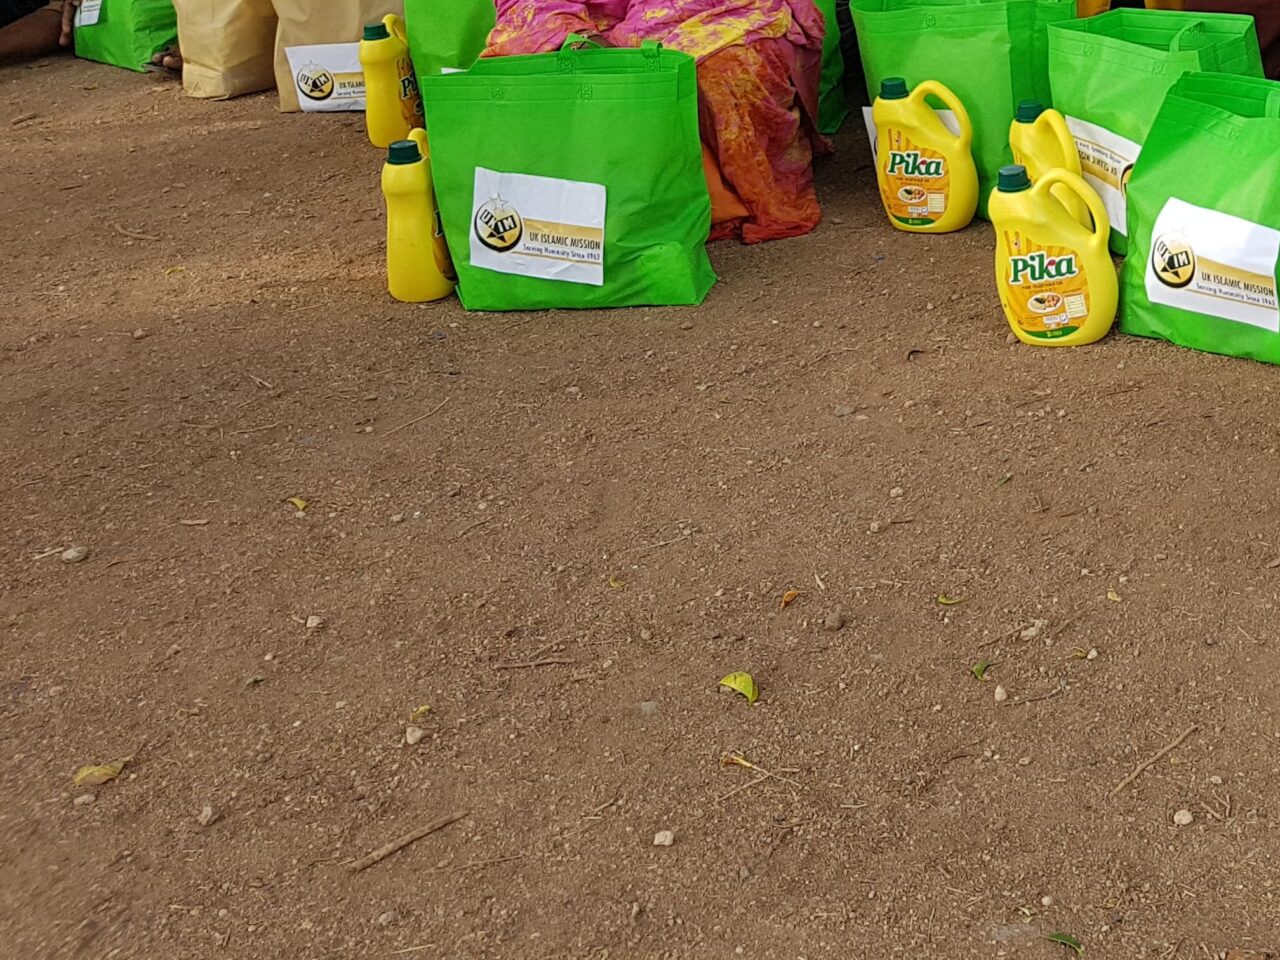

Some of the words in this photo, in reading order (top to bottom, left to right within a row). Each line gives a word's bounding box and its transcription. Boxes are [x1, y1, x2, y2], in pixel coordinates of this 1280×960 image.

[887, 151, 943, 176] Pika
[529, 232, 539, 241] UK
[541, 233, 568, 247] ISLAMIC
[570, 239, 600, 250] MISSION
[1010, 253, 1077, 283] Pika
[1201, 272, 1211, 282] UK
[1213, 274, 1241, 289] ISLAMIC
[1243, 282, 1274, 296] MISSION
